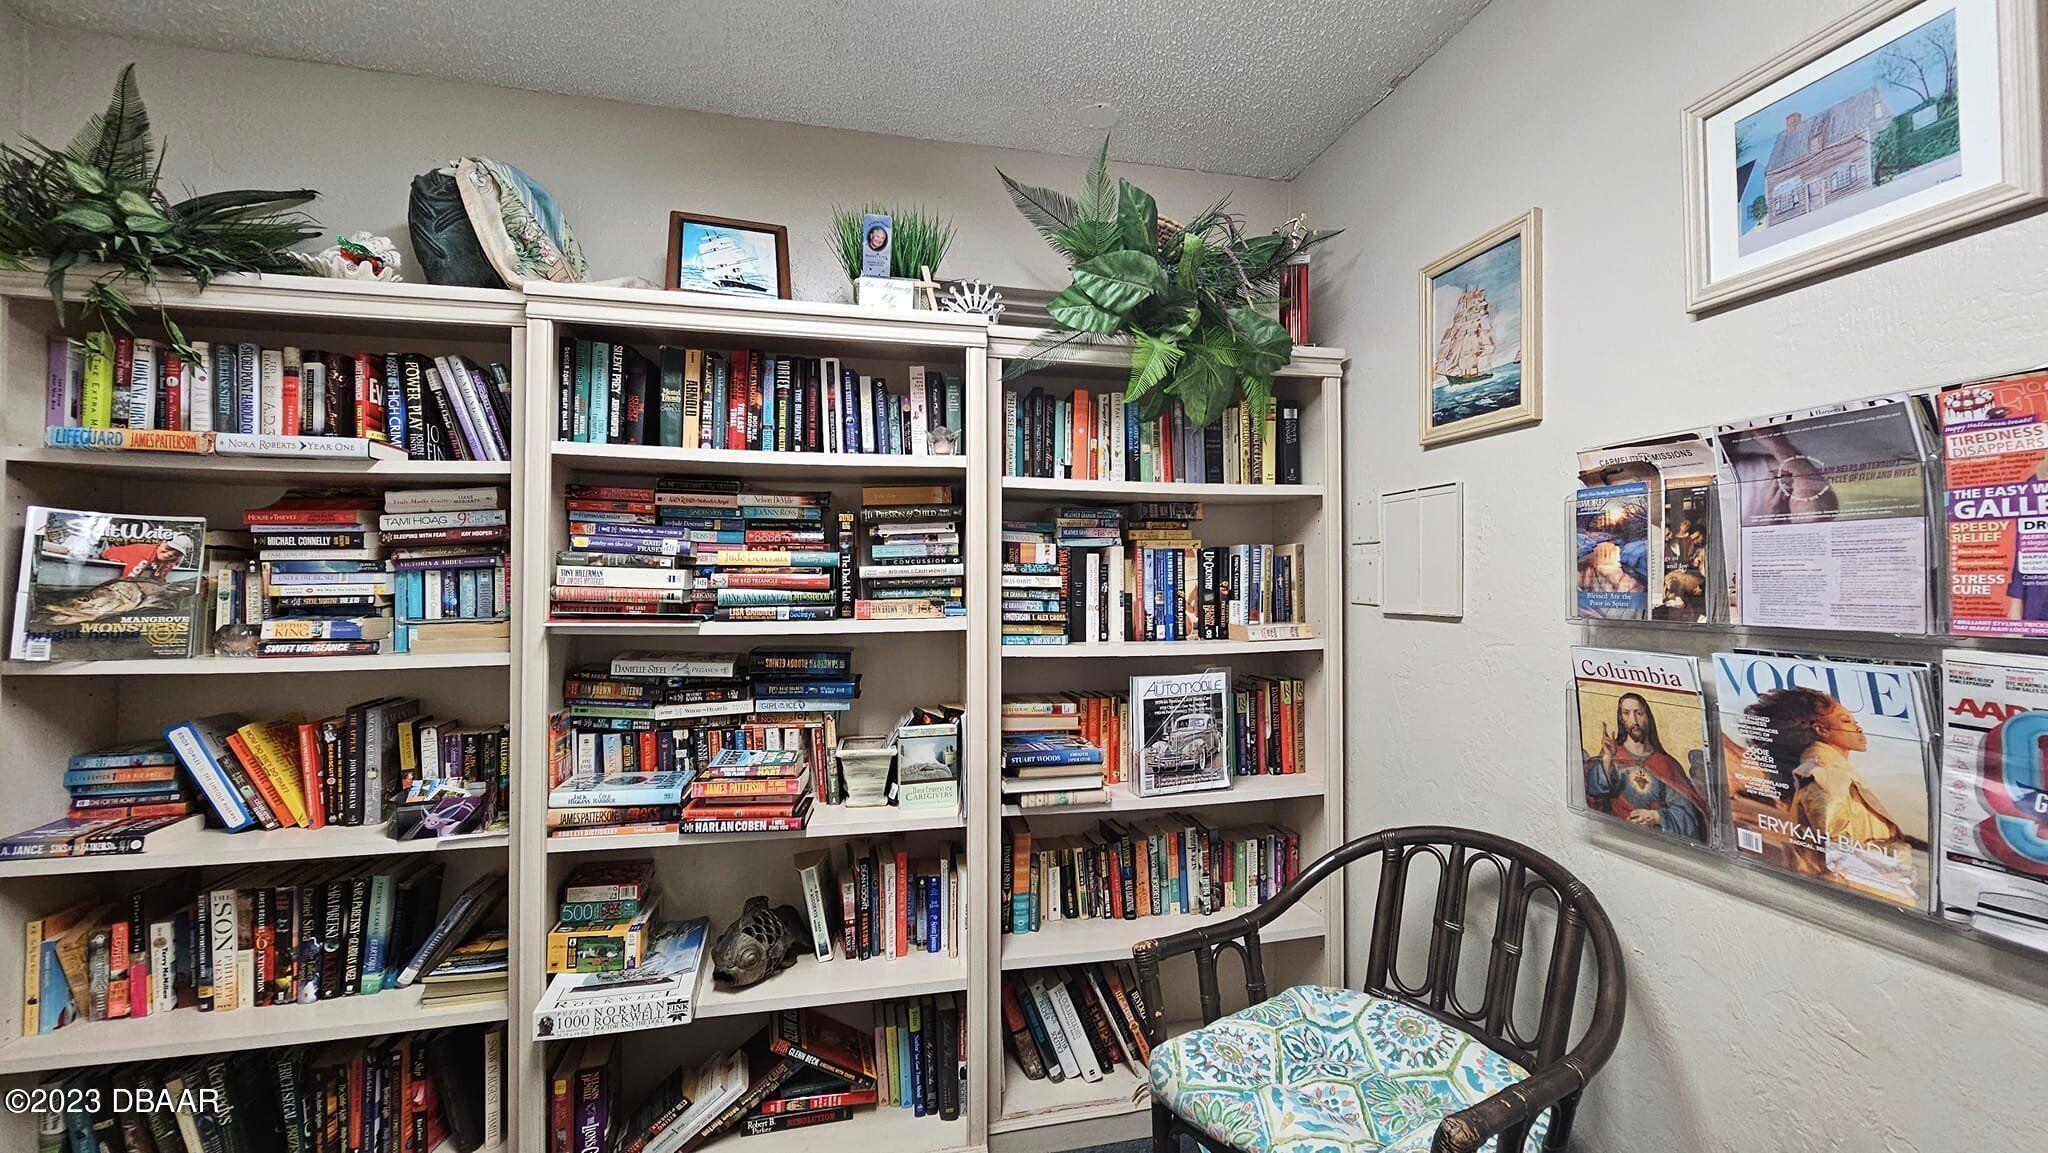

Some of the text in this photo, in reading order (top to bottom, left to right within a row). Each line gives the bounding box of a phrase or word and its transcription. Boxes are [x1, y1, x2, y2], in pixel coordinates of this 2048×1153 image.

[611, 345, 623, 394] SILENT PREY
[777, 360, 791, 389] VORTEX
[405, 362, 422, 434] POWER PLAY
[685, 380, 698, 417] ARNOLD
[730, 407, 738, 428] TRIAL
[737, 402, 745, 433] THE LAST
[794, 403, 802, 441] BLUEPRINT
[1007, 398, 1016, 439] HIMSELF
[2007, 416, 2033, 426] treats!
[55, 427, 123, 447] LIFEGUARD
[130, 432, 197, 450] JAMES PATTERSON
[228, 438, 296, 450] NORA ROBERTS
[763, 430, 773, 451] BOONE
[1950, 425, 2044, 447] TIREDNESS
[306, 442, 355, 451] YEAR ONE
[1651, 449, 1693, 461] MISSIONS
[1952, 438, 2045, 458] DISAPPEARS
[1826, 475, 1848, 484] CYCLE
[1859, 473, 1875, 482] ITCH
[1875, 470, 1892, 479] AND
[1893, 467, 1918, 478] HIVES.
[1952, 489, 1981, 500] THE
[1984, 484, 2029, 496] EASY
[66, 518, 184, 540] SltWater
[384, 515, 448, 527] TAMI HOAG
[1951, 521, 2010, 533] SPEEDY
[267, 535, 331, 546] MICHAEL CONNELLY
[1952, 532, 2003, 543] RELIEF
[842, 554, 851, 567] The
[574, 569, 604, 577] HILLERMAN
[842, 567, 851, 586] Dark
[1060, 548, 1070, 598] SARA PARETSKY
[1204, 562, 1214, 590] COUNTRY
[1951, 574, 2006, 584] STRESS
[1952, 585, 1992, 595] CURE
[1611, 600, 1629, 608] Spirit
[78, 623, 190, 633] MONSTERS
[120, 616, 191, 624] MANGROVE
[26, 629, 141, 643] bright house
[274, 627, 310, 637] KING
[264, 642, 350, 653] SWIFT VENGEANCE
[614, 664, 667, 673] DANIELLE STEEL
[765, 658, 786, 668] GENIUS
[786, 659, 808, 669] BLOODY
[1581, 659, 1683, 688] Columbia
[1143, 679, 1223, 697] AUTOMOBILE
[1719, 657, 1910, 719] VOGUE
[500, 737, 508, 775] KELLERMAN
[1743, 752, 1775, 764] COMER
[349, 758, 357, 809] JOHN GRISHAM
[704, 782, 766, 795] JAMES PATTERSON
[905, 792, 953, 801] CAREGIVERS
[560, 810, 618, 824] JAMES PATTERSON
[695, 820, 768, 833] HARLAN COBEN
[1757, 813, 1899, 861] ERYKAH BADU
[258, 890, 266, 909] JAMES
[861, 884, 869, 911] KOONTZ
[302, 888, 314, 942] Daniel Silva
[325, 884, 341, 940] SARA PARETSKY
[562, 903, 593, 921] 500
[213, 901, 233, 951] SON
[346, 881, 365, 983] SARA PARETSKY GUARDIAN ANGEL
[369, 938, 378, 972] BEARTOWN
[161, 947, 169, 1000] Terry McMillan
[256, 953, 265, 992] EXTINCTION
[594, 1001, 665, 1016] NORMAN
[667, 1004, 689, 1012] FINK
[557, 1015, 590, 1030] 1000
[594, 1011, 665, 1026] ROCKWELL
[788, 1047, 820, 1067] GLENN BECK
[206, 1060, 235, 1126] Kennedys
[278, 1061, 297, 1121] ERICH SEGAL
[747, 1117, 777, 1130] Robert B.
[751, 1125, 772, 1135] Parker
